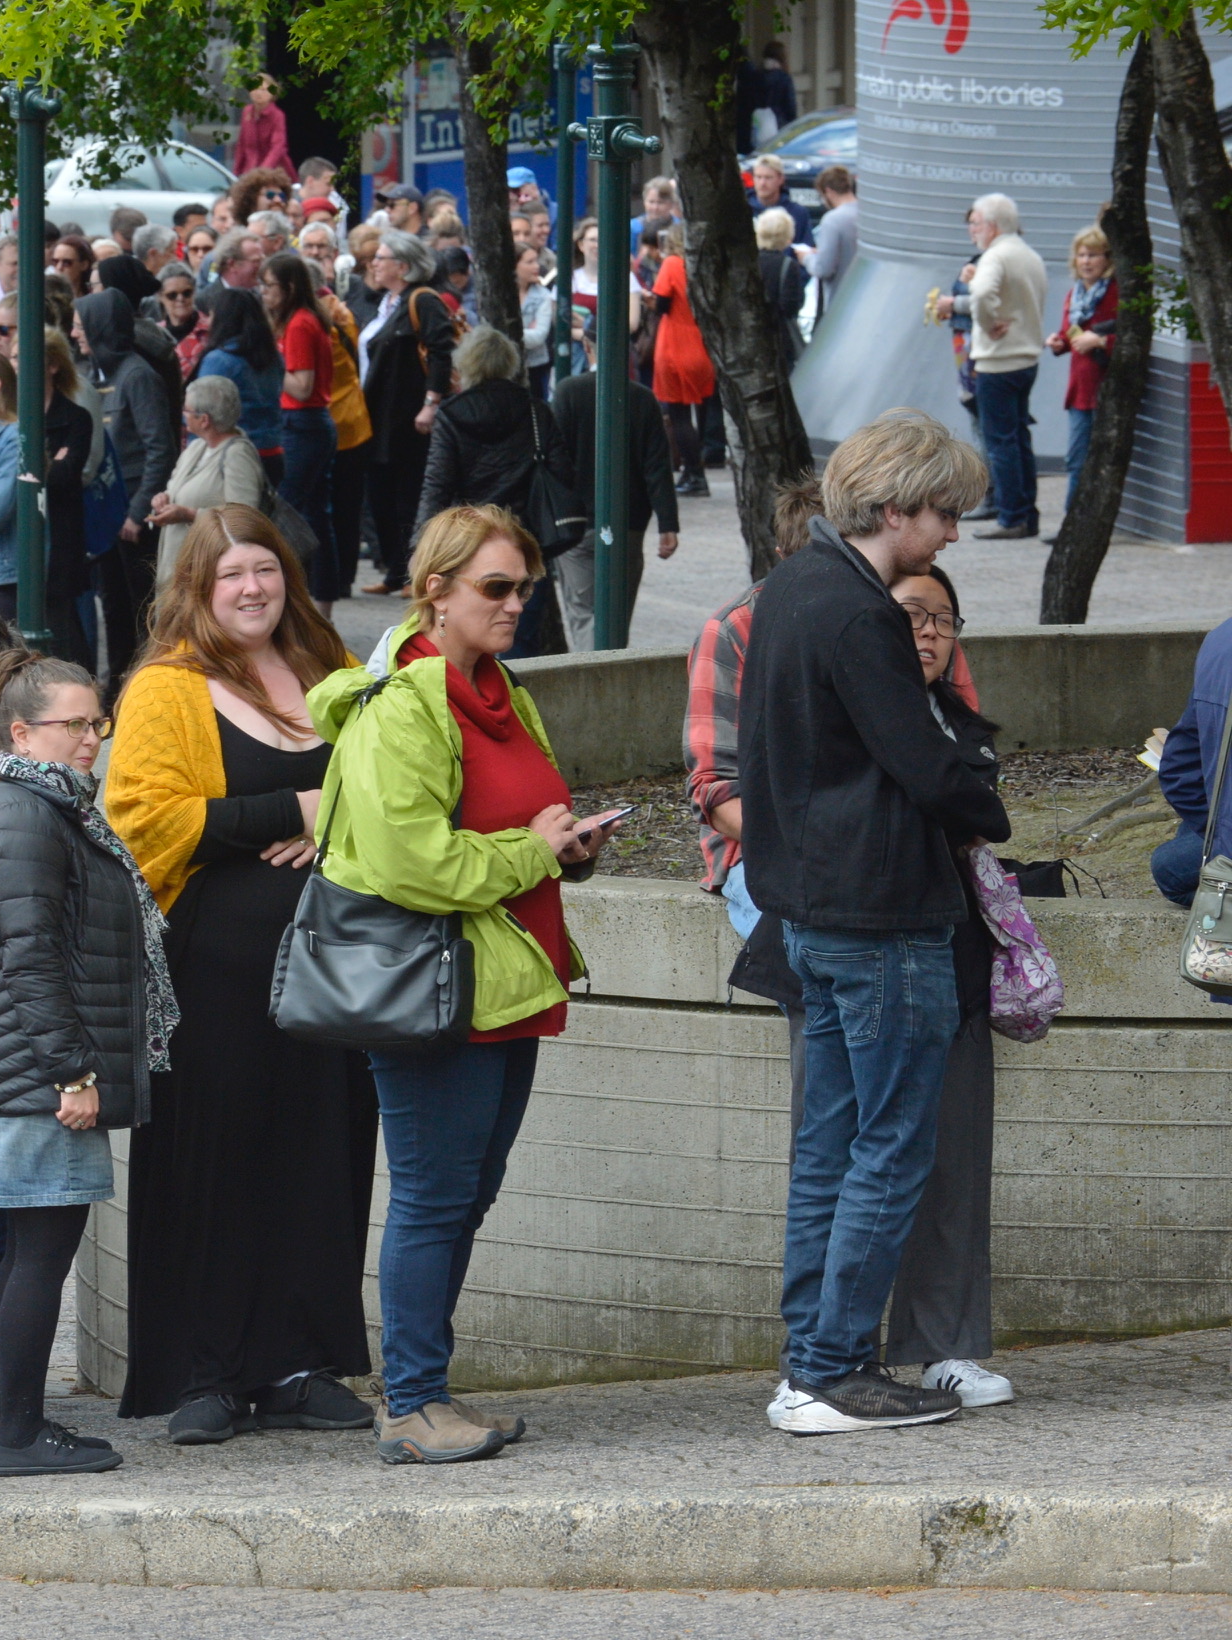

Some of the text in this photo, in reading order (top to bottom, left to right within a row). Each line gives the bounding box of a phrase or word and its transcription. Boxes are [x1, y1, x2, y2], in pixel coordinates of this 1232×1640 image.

[897, 75, 954, 108] public
[961, 77, 1064, 107] libraries
[420, 102, 555, 150] Intnet
[980, 169, 1009, 184] CITY
[1011, 170, 1076, 185] COUNCIL
